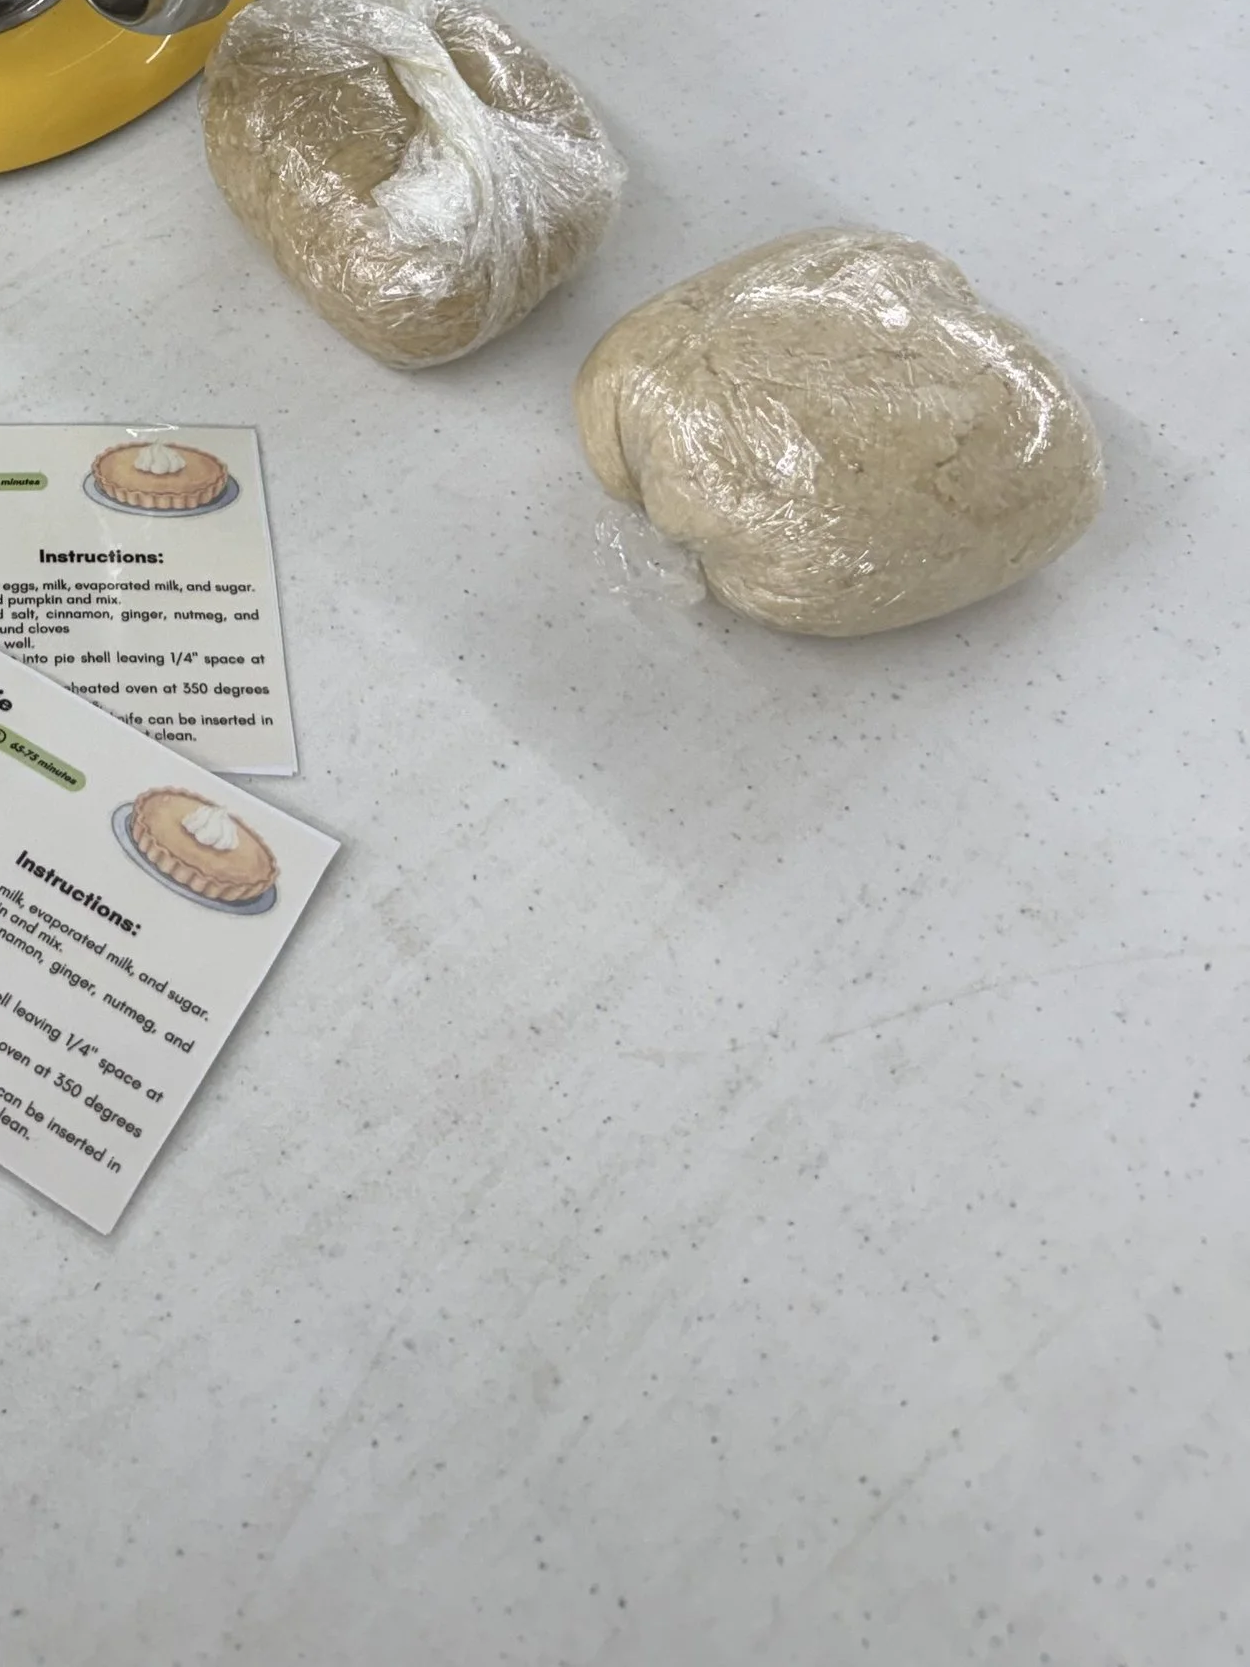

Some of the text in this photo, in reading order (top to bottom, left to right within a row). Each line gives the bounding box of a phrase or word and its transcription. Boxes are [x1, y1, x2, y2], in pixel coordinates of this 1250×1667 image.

[39, 549, 164, 564] Instructions:
[0, 583, 39, 596] eggs,
[42, 579, 71, 596] milk,
[74, 579, 151, 596] evaporated
[154, 579, 183, 593] milk,
[186, 580, 212, 592] and
[214, 584, 255, 596] sugar.
[7, 594, 63, 608] pumpkin
[66, 594, 92, 605] and
[96, 595, 121, 605] mix.
[11, 607, 39, 621] salt,
[46, 609, 114, 621] cinnamon,
[120, 609, 167, 623] ginger,
[174, 610, 227, 623] nutmeg,
[233, 608, 260, 621] and
[28, 623, 70, 634] cloves
[3, 637, 35, 650] well.
[22, 653, 48, 668] into
[54, 653, 75, 667] pie
[80, 650, 111, 664] shell
[116, 650, 165, 667] leaving
[170, 651, 198, 667] 1/4"
[204, 655, 245, 668] space
[250, 654, 265, 665] at
[125, 682, 270, 697] oven at 350 degrees
[148, 712, 274, 726] can be inserted in
[153, 729, 197, 742] clean.
[37, 759, 77, 785] minutes
[15, 849, 141, 936] Instructions:
[9, 913, 39, 934] and
[37, 930, 62, 952] mix.
[28, 904, 107, 956] evaporated
[105, 951, 135, 977] milk,
[138, 972, 169, 994] and
[166, 989, 208, 1021] sugar.
[48, 960, 96, 996] ginger,
[101, 992, 156, 1034] nutmeg,
[163, 1031, 195, 1053] and
[12, 999, 62, 1042] leaving
[65, 1032, 98, 1056] 1/4"
[97, 1057, 142, 1090] space
[145, 1088, 163, 1103] at
[33, 1063, 51, 1078] at
[52, 1072, 82, 1098] 350
[83, 1093, 142, 1138] degrees
[24, 1100, 44, 1122] be
[46, 1116, 107, 1162] inserted
[106, 1156, 121, 1173] in
